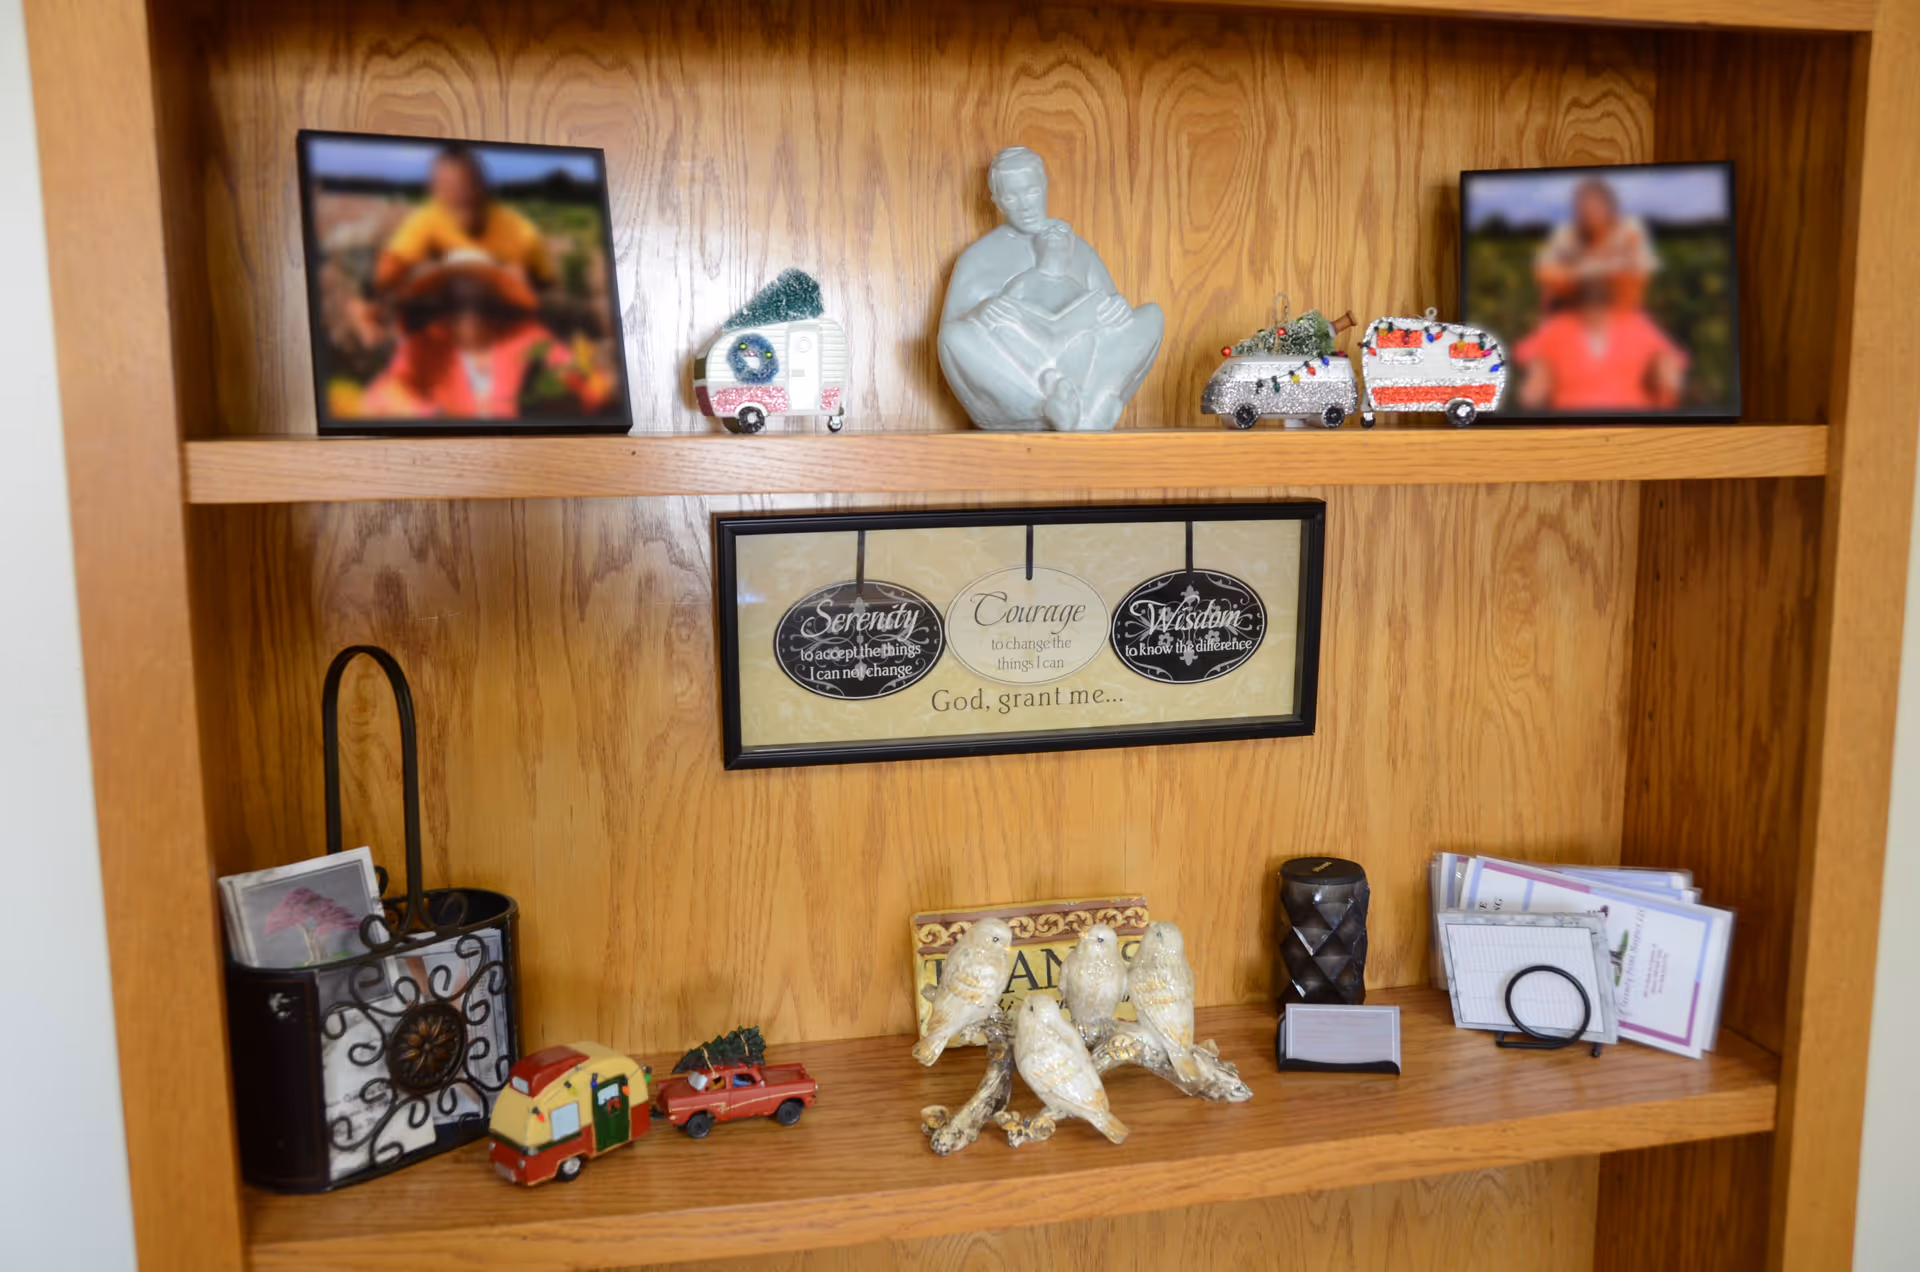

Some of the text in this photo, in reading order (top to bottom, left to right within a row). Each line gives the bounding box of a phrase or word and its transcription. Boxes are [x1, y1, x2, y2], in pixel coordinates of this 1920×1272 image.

[800, 599, 920, 641] Serenity
[970, 591, 1086, 635] Courage
[1130, 595, 1242, 635] Wisdom
[800, 642, 921, 662] to accept the things
[991, 635, 1072, 652] to change the
[1125, 639, 1253, 656] to know the difference
[810, 663, 913, 680] I can not change
[997, 656, 1064, 672] things I can
[931, 687, 1124, 714] God, grant me...
